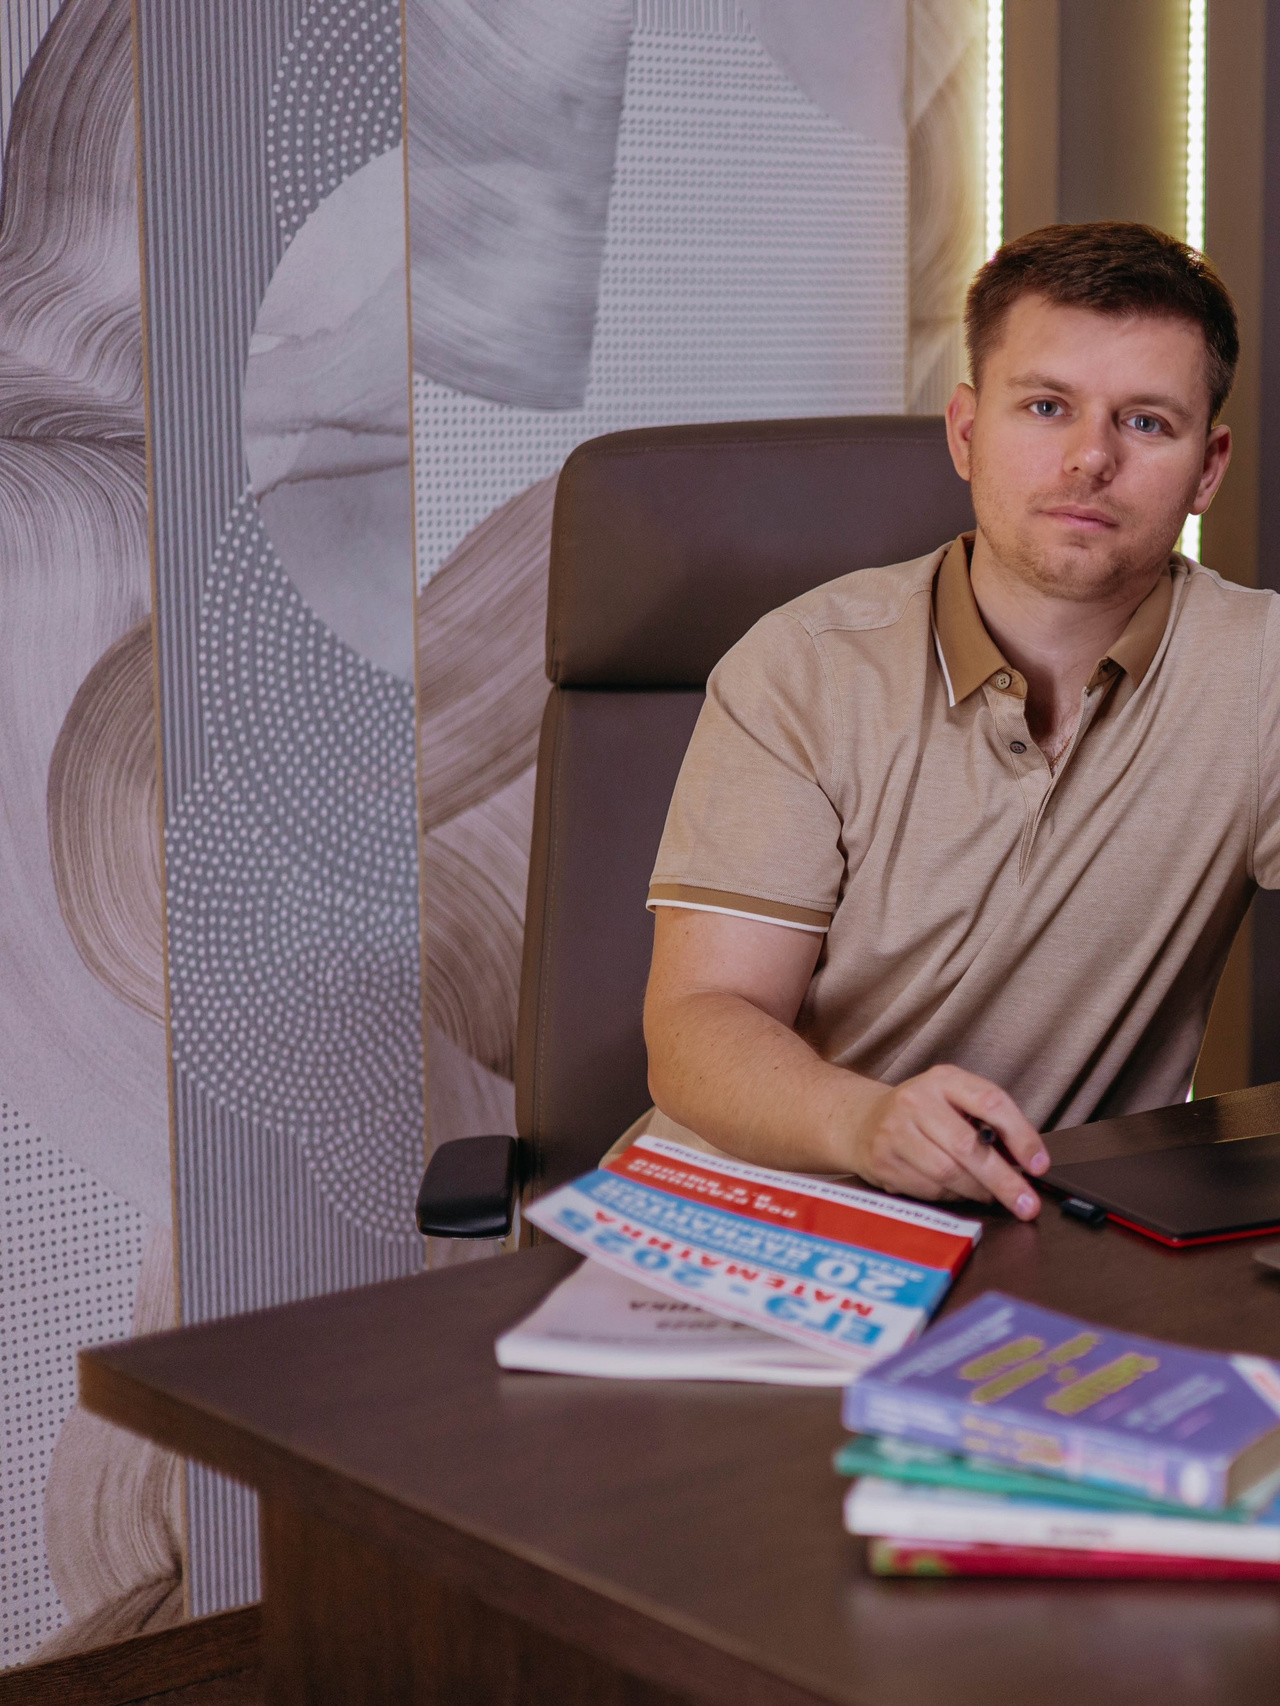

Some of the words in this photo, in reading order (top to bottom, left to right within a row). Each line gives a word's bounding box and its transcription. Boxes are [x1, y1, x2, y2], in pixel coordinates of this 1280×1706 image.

[750, 1198, 796, 1219] ПОД
[592, 1209, 876, 1318] МАТЕМАТИКА
[813, 1257, 909, 1300] 20
[763, 1292, 889, 1347] ЕГЭ
